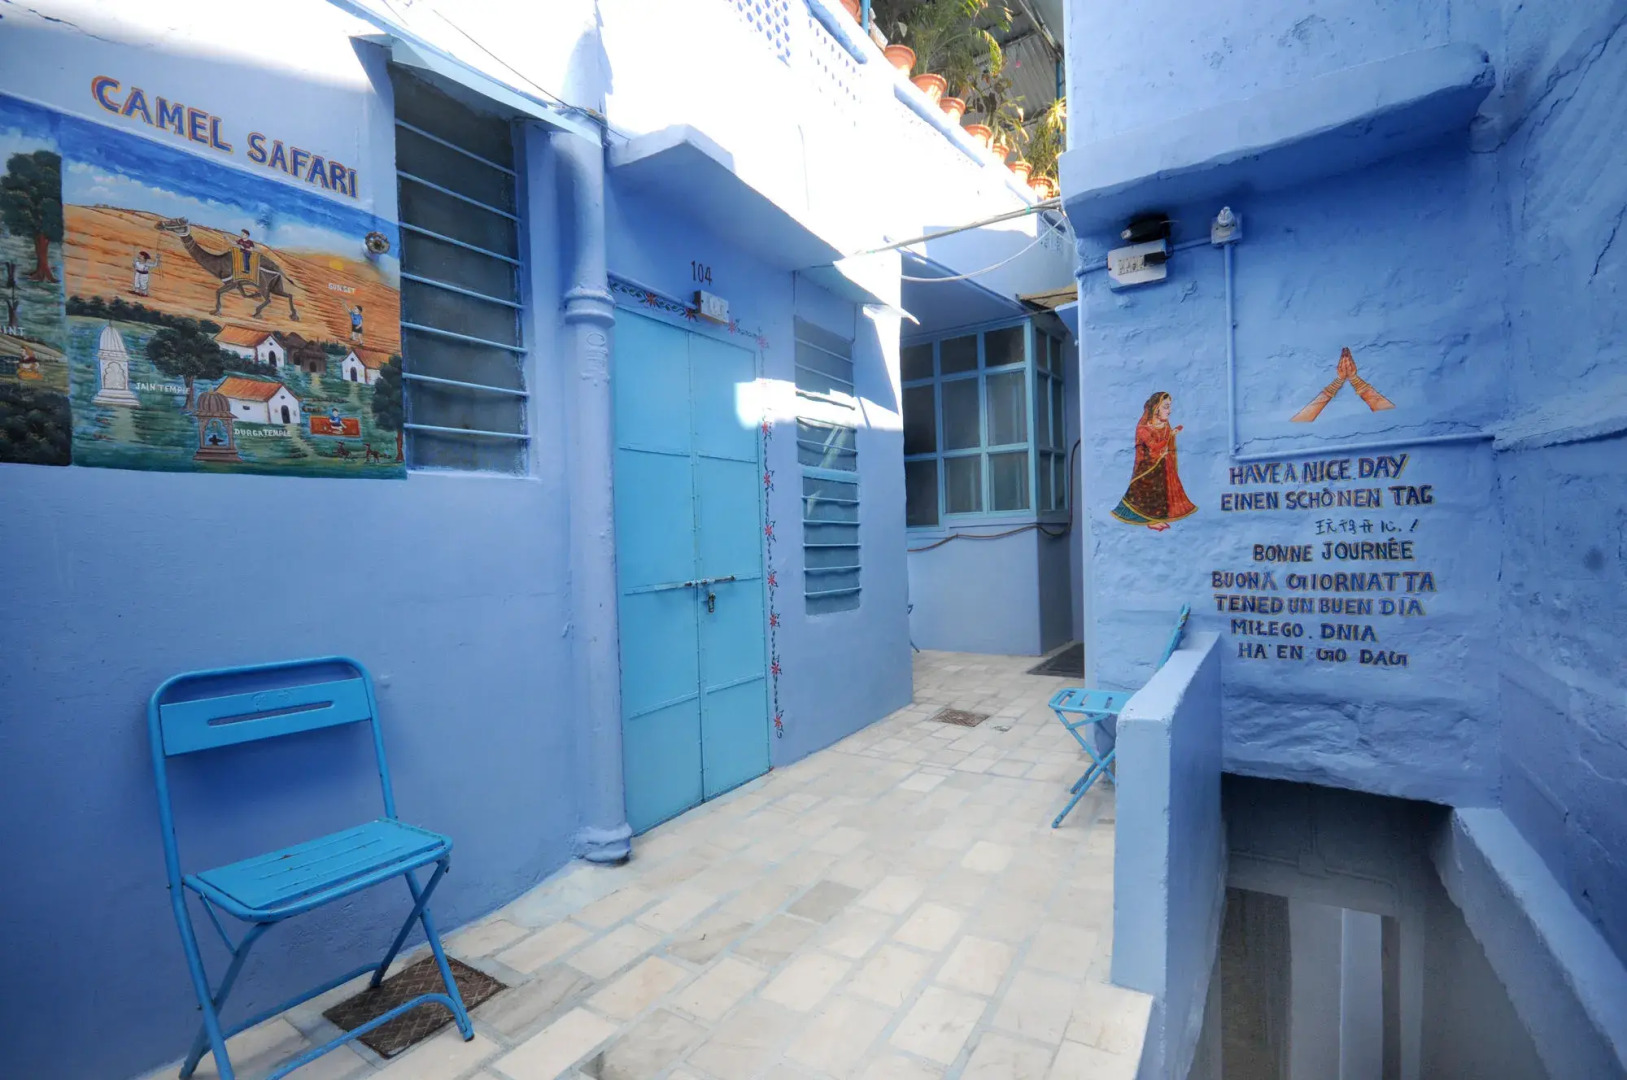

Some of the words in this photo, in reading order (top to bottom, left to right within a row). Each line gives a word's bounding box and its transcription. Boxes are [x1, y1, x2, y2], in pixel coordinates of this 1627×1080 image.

[91, 75, 234, 154] CAMEL
[247, 131, 359, 199] SAFARI
[691, 260, 713, 286] 104
[0, 325, 25, 337] INT
[135, 382, 156, 392] JAIN
[157, 384, 191, 395] TEMPLE
[1358, 453, 1410, 479] DAY
[1220, 492, 1281, 512] EINEN
[1388, 485, 1434, 506] TAG
[1253, 544, 1313, 562] BONNE
[1321, 537, 1415, 561] JOURNÉE
[1211, 571, 1278, 591] BUONA
[1214, 594, 1285, 615] TENED
[1287, 596, 1315, 615] UN
[1318, 596, 1373, 615] BUEN
[1320, 622, 1379, 643] DNIA
[1276, 644, 1305, 660] EN
[1315, 647, 1347, 662] GO
[1359, 648, 1409, 668] DAG
